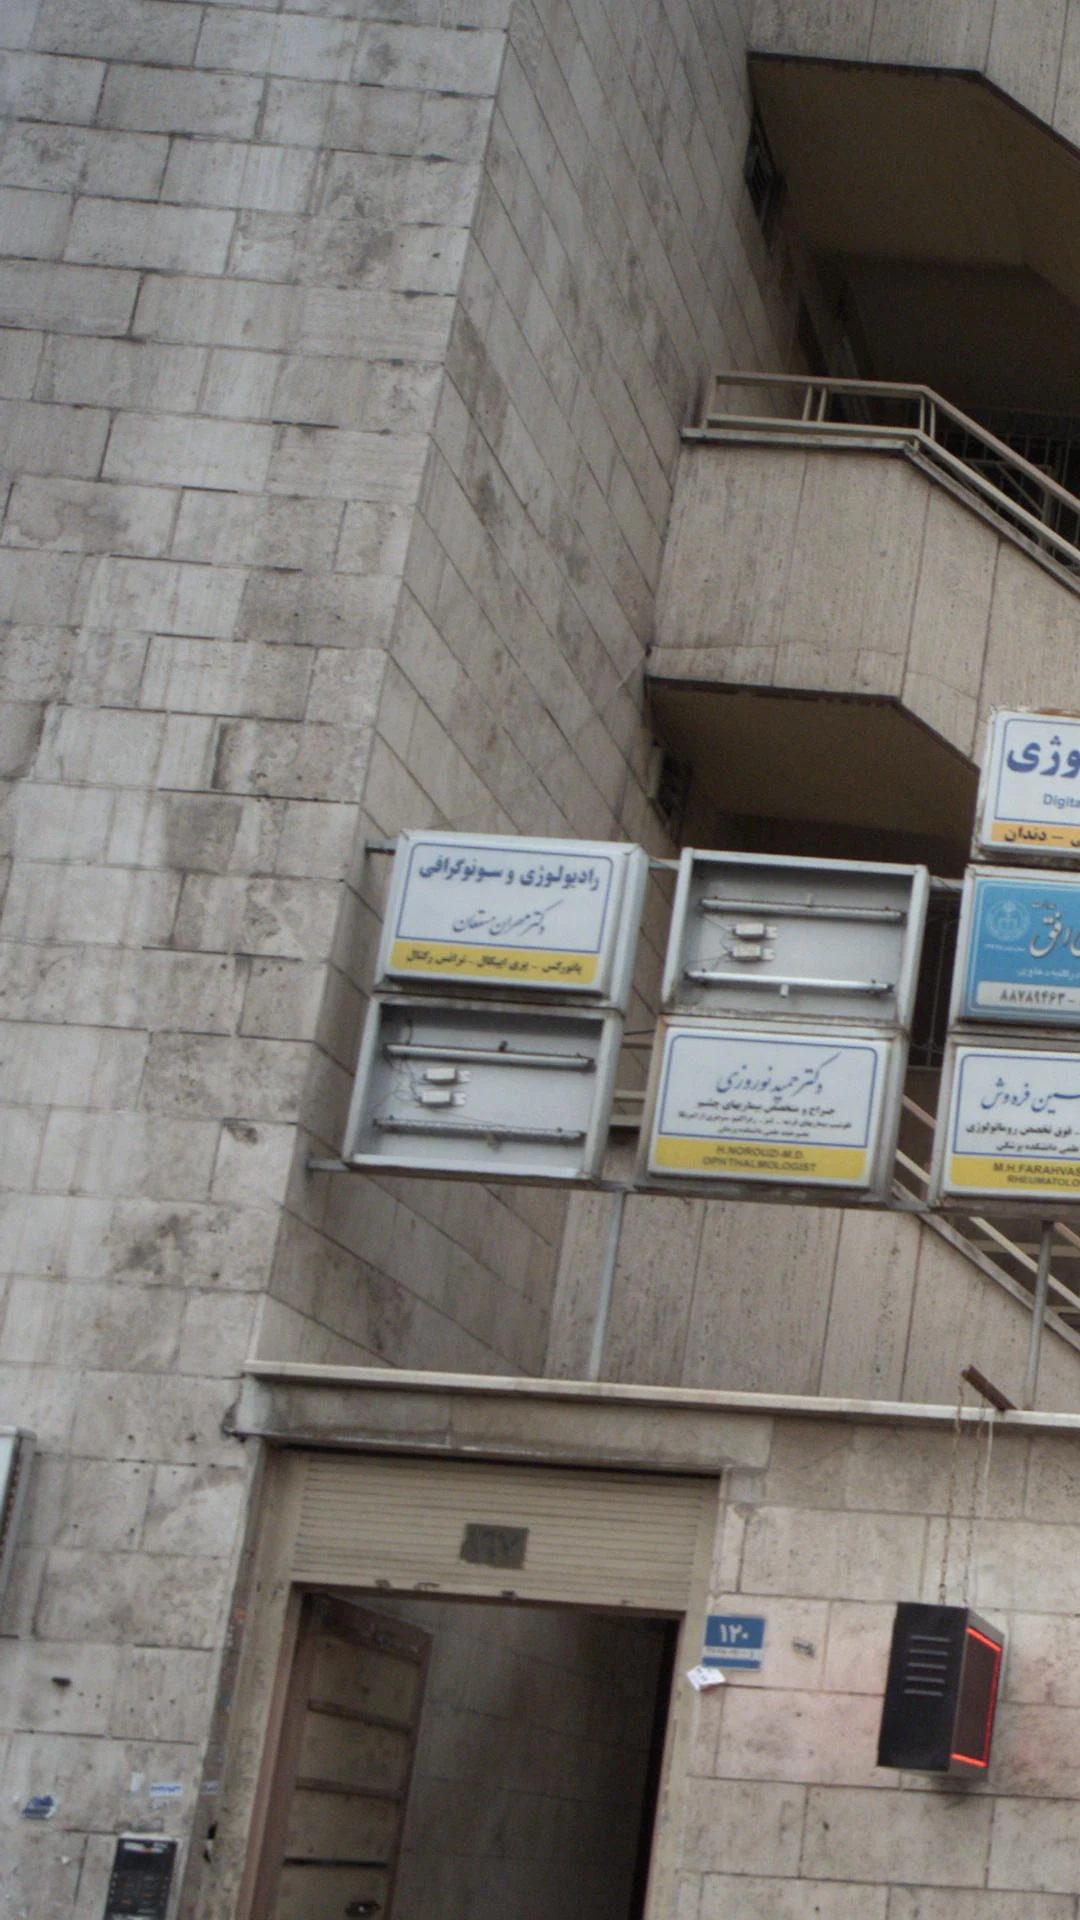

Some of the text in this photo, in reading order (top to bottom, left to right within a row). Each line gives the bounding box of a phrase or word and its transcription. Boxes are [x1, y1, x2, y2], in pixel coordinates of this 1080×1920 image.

[1004, 827, 1047, 841] دندان
[419, 855, 502, 882] سونوگرافی
[504, 870, 514, 886] و
[519, 899, 565, 937] دکتر
[716, 1052, 842, 1101] دکتر حمید نوروزی
